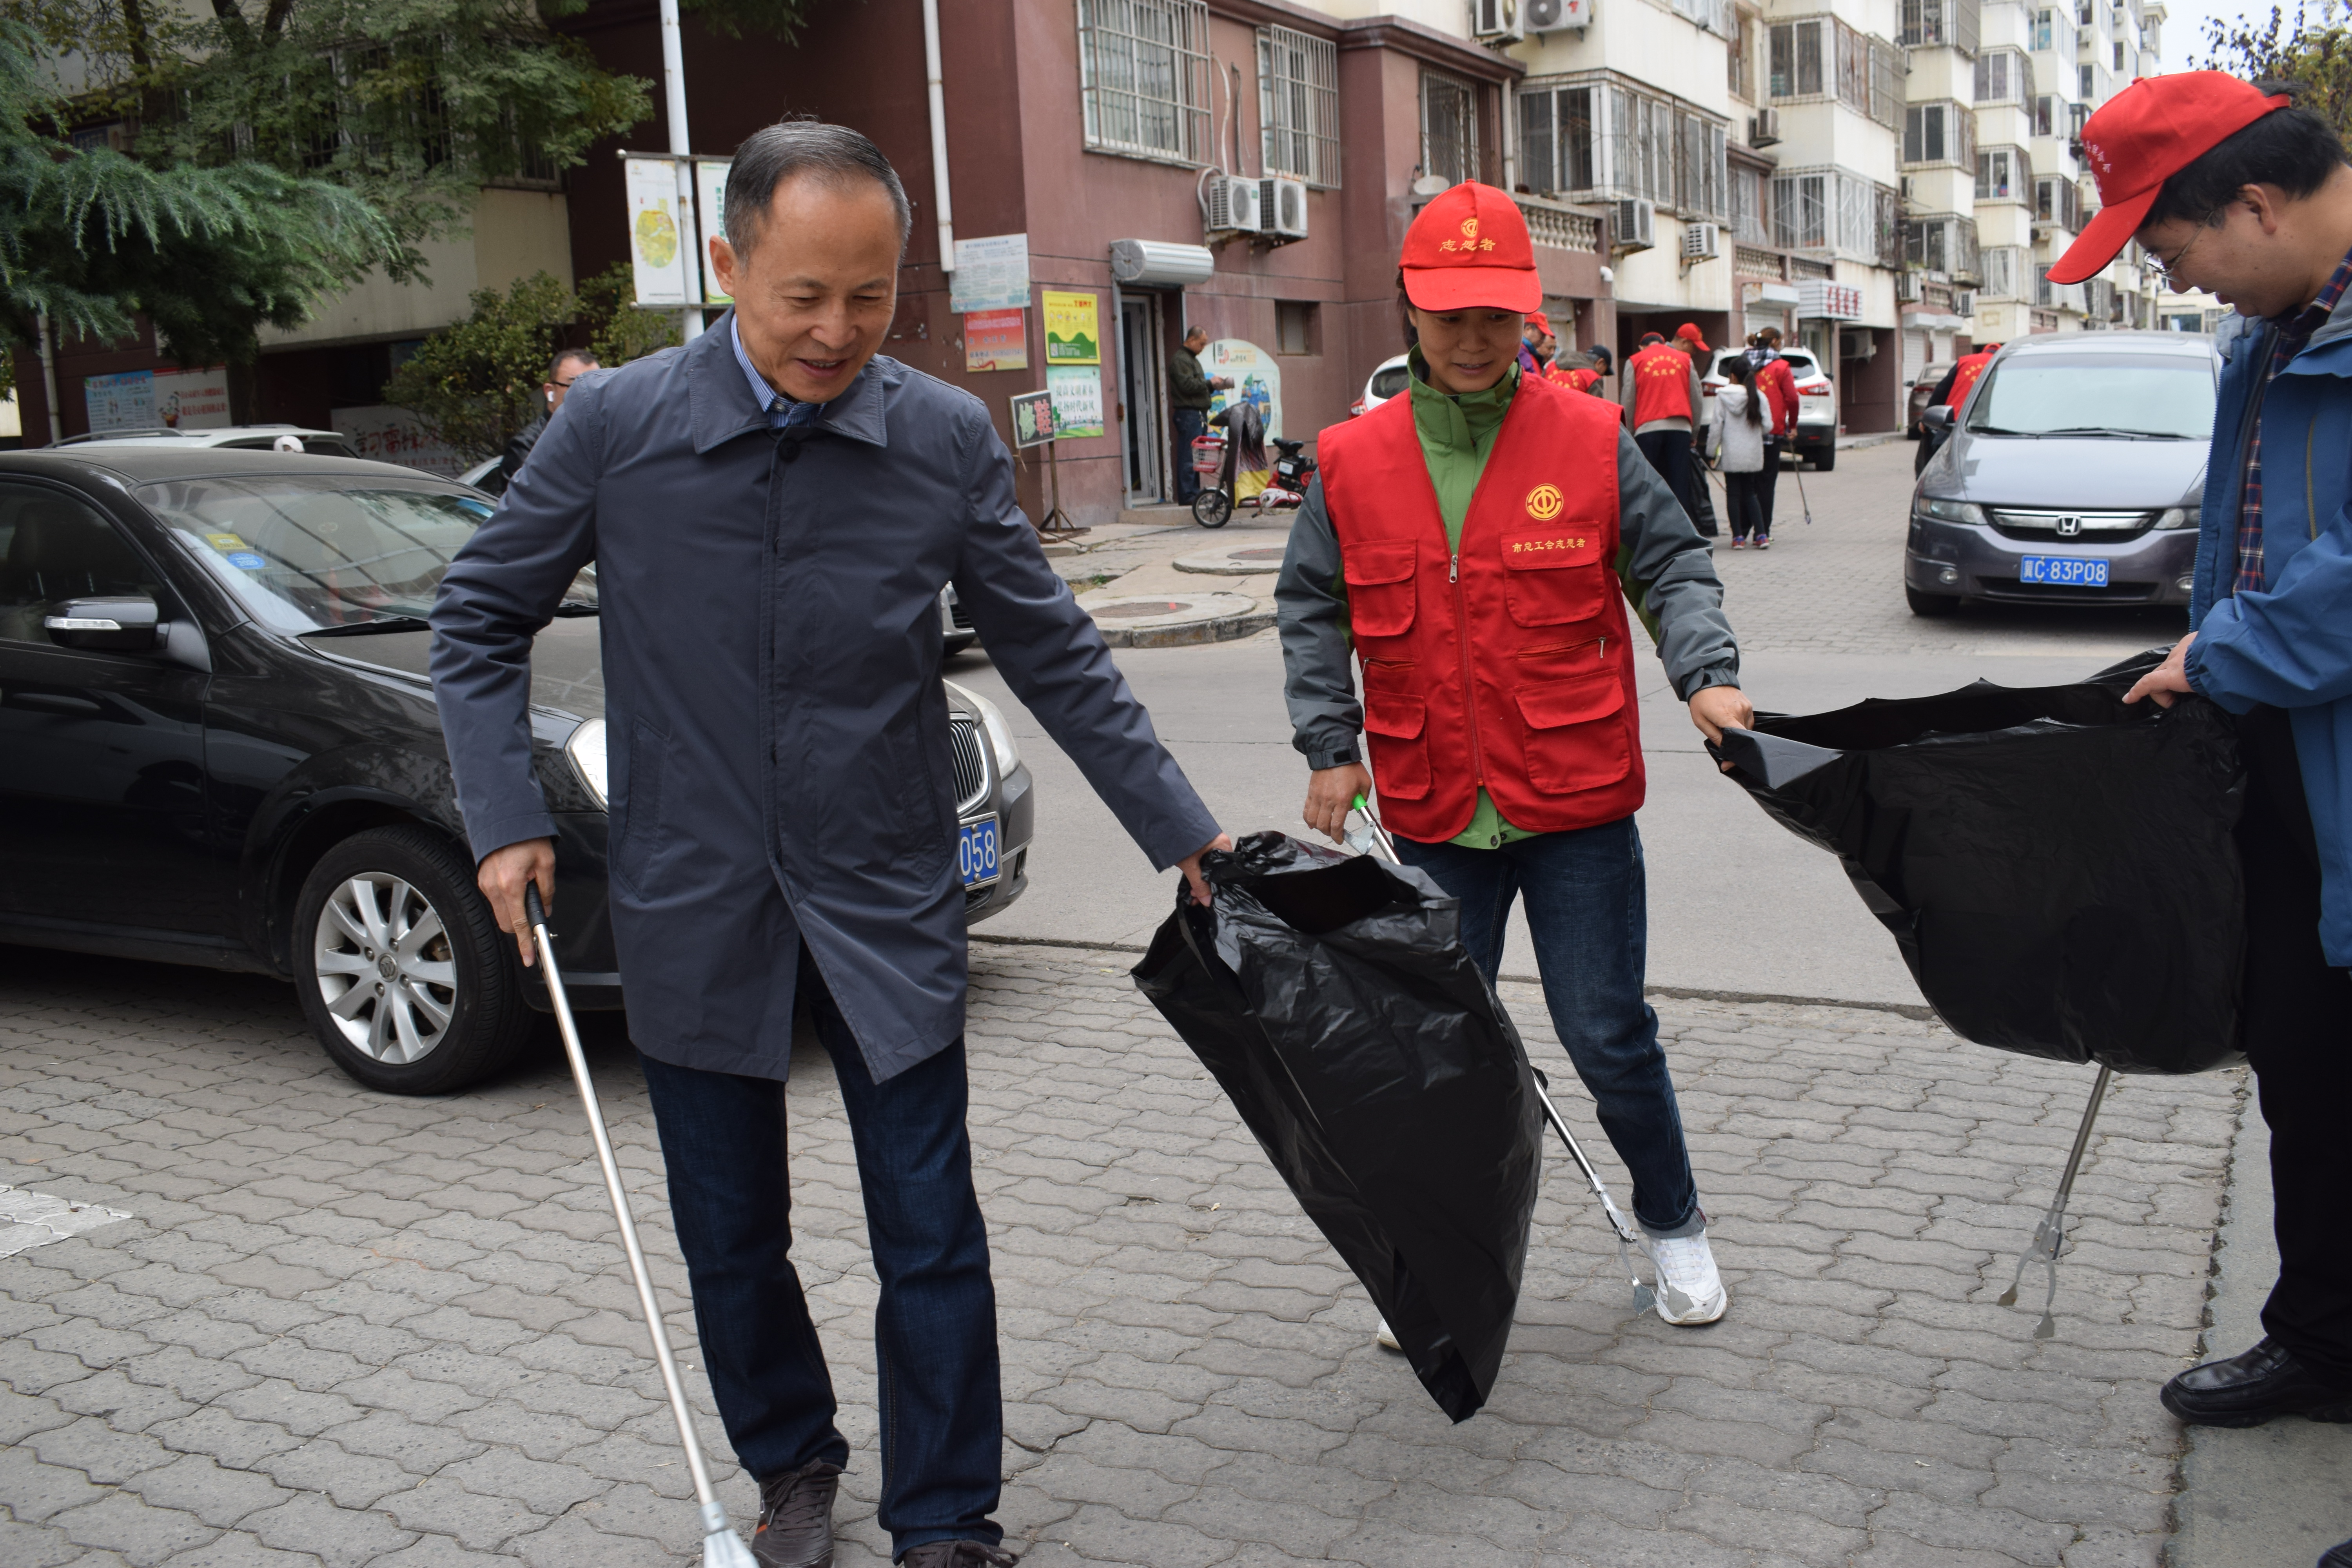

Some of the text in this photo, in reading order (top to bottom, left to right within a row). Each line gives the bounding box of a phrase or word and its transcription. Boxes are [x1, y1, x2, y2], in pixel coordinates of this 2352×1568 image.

[1018, 398, 1053, 441] 修鞋
[1512, 537, 1586, 553] 市总工会志愿者
